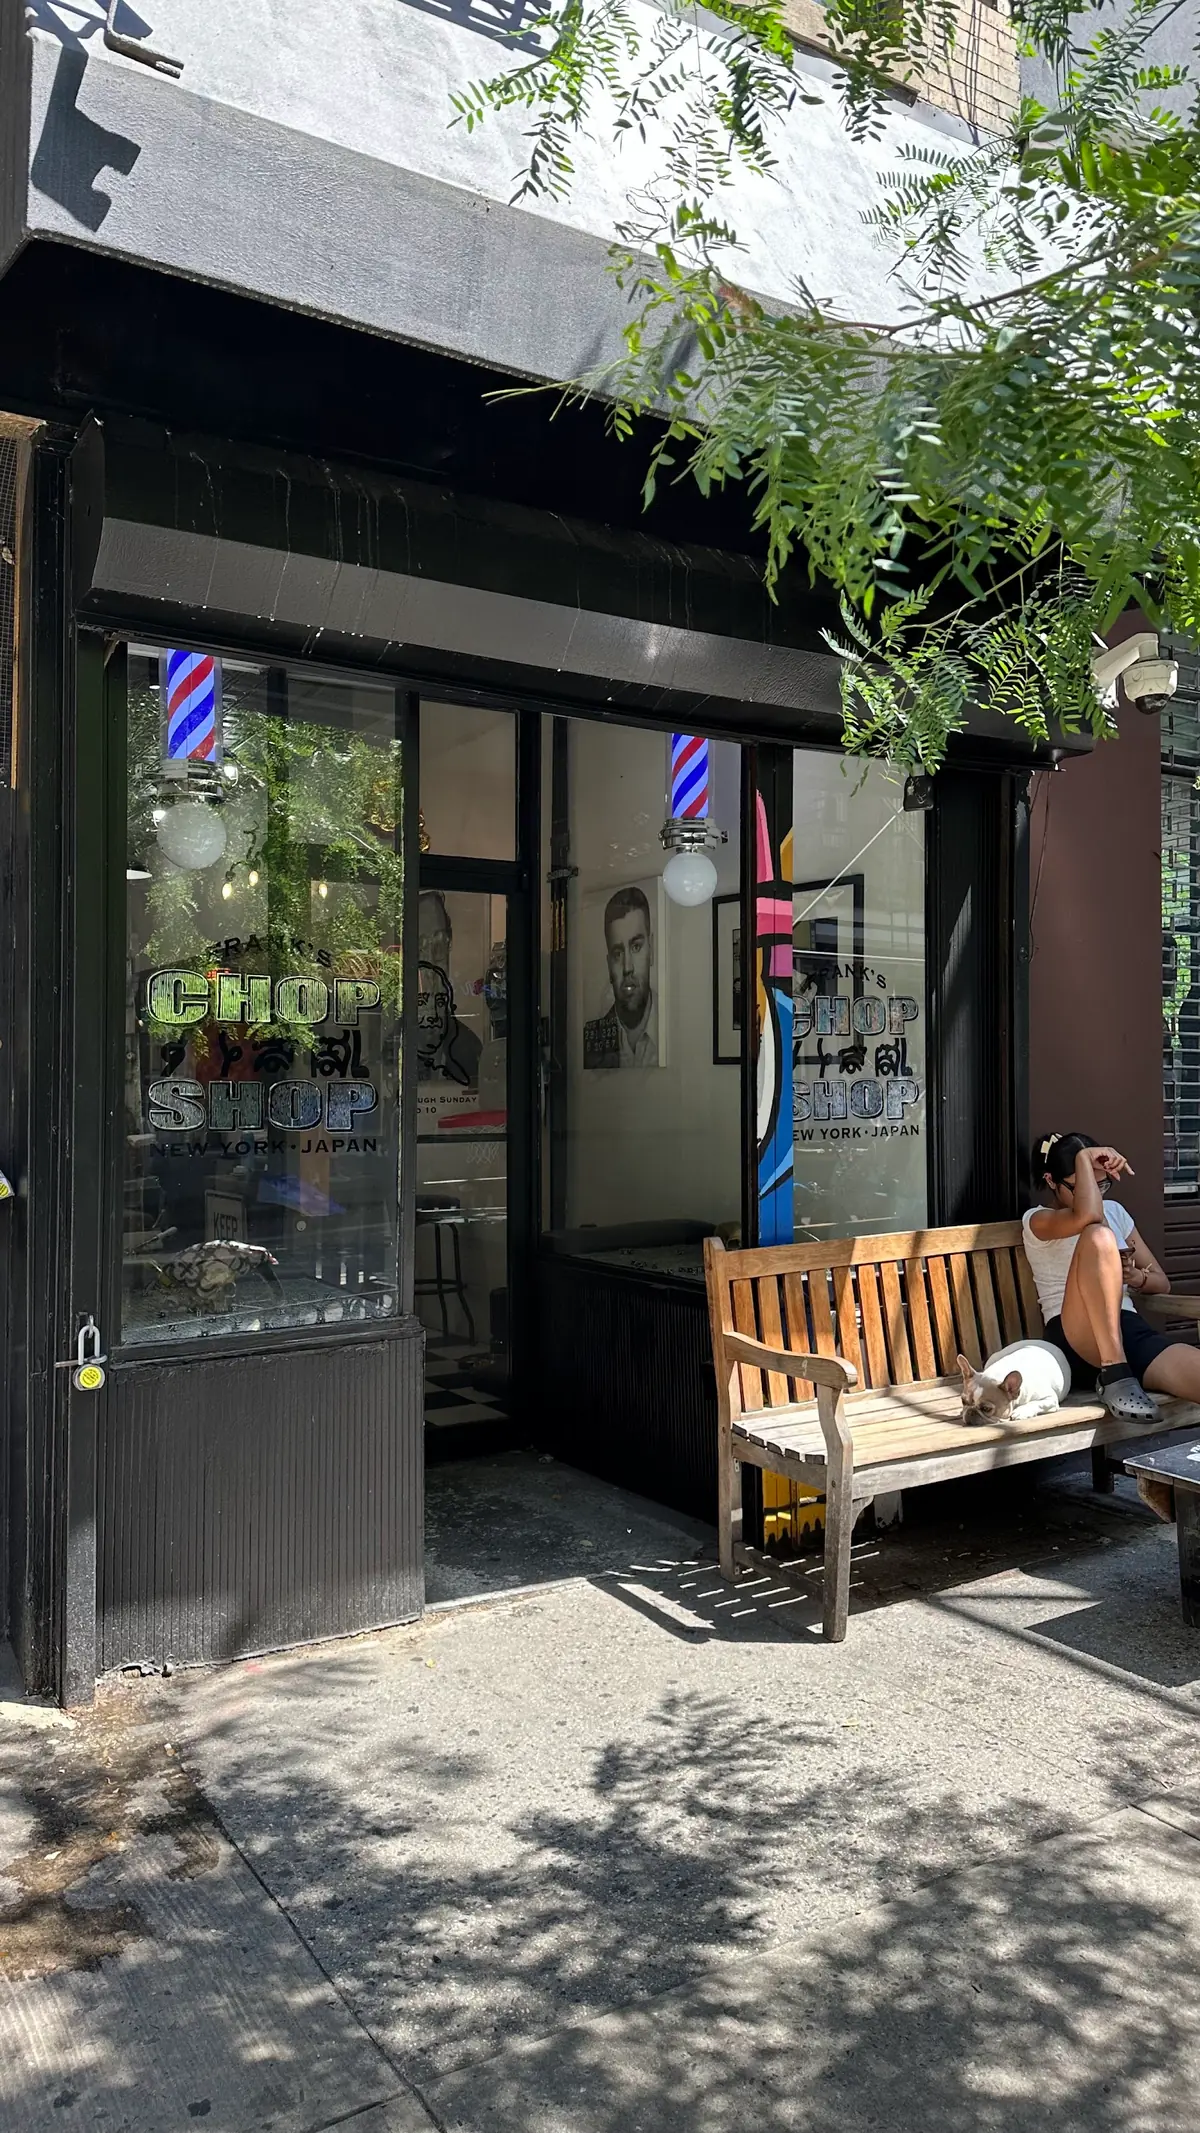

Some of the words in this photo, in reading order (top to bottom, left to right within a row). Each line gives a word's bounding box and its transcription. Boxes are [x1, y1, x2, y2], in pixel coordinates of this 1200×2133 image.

[808, 962, 887, 990] RANK'S
[146, 968, 381, 1026] CHOP
[792, 995, 920, 1039] CHOP
[148, 1078, 379, 1133] SHOP
[426, 1106, 437, 1114] 10
[440, 1096, 477, 1104] SUNDAY
[792, 1078, 920, 1123] SHOP
[792, 1129, 815, 1141] EW
[820, 1127, 862, 1140] YORK
[871, 1125, 920, 1138] JAPAN
[149, 1142, 209, 1158] NEW
[220, 1140, 286, 1156] YORK
[300, 1138, 377, 1154] JAPAN
